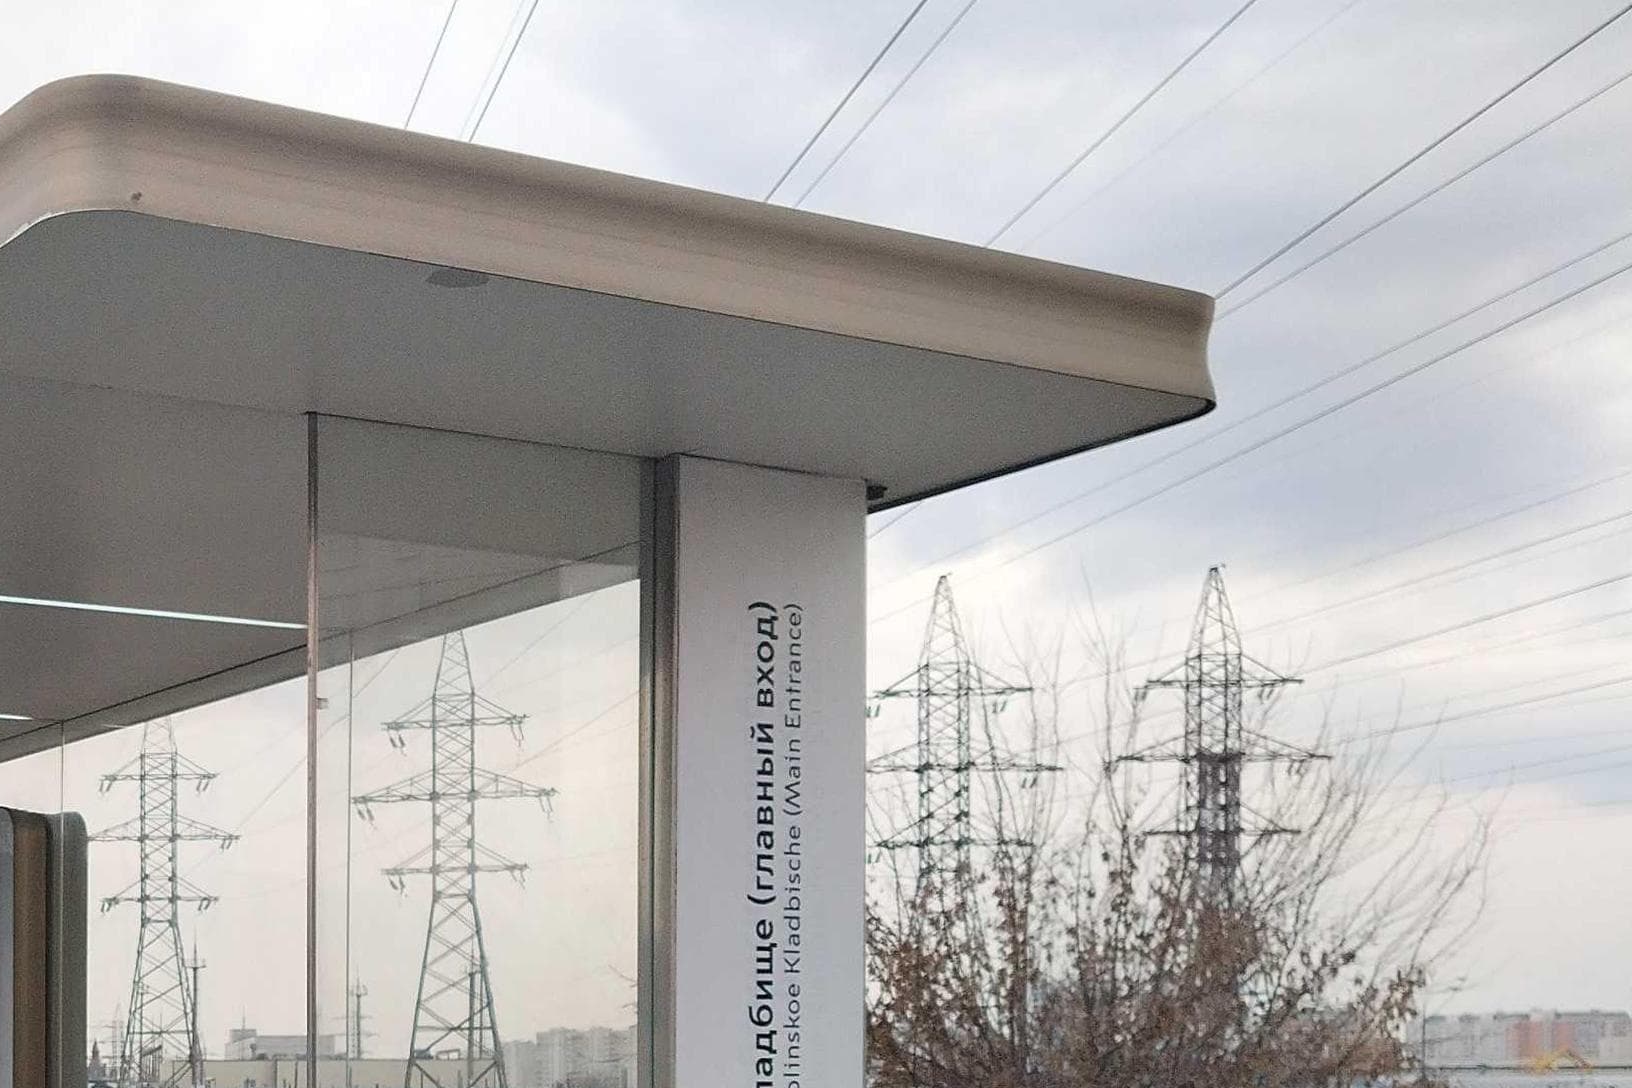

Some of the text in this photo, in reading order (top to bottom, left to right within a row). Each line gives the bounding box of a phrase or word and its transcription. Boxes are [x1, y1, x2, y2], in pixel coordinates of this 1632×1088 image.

[748, 601, 779, 708] вход)
[783, 602, 804, 729] Entrance)
[747, 724, 777, 906] (главный
[783, 738, 803, 817] (Main
[783, 824, 802, 974] Kladbische
